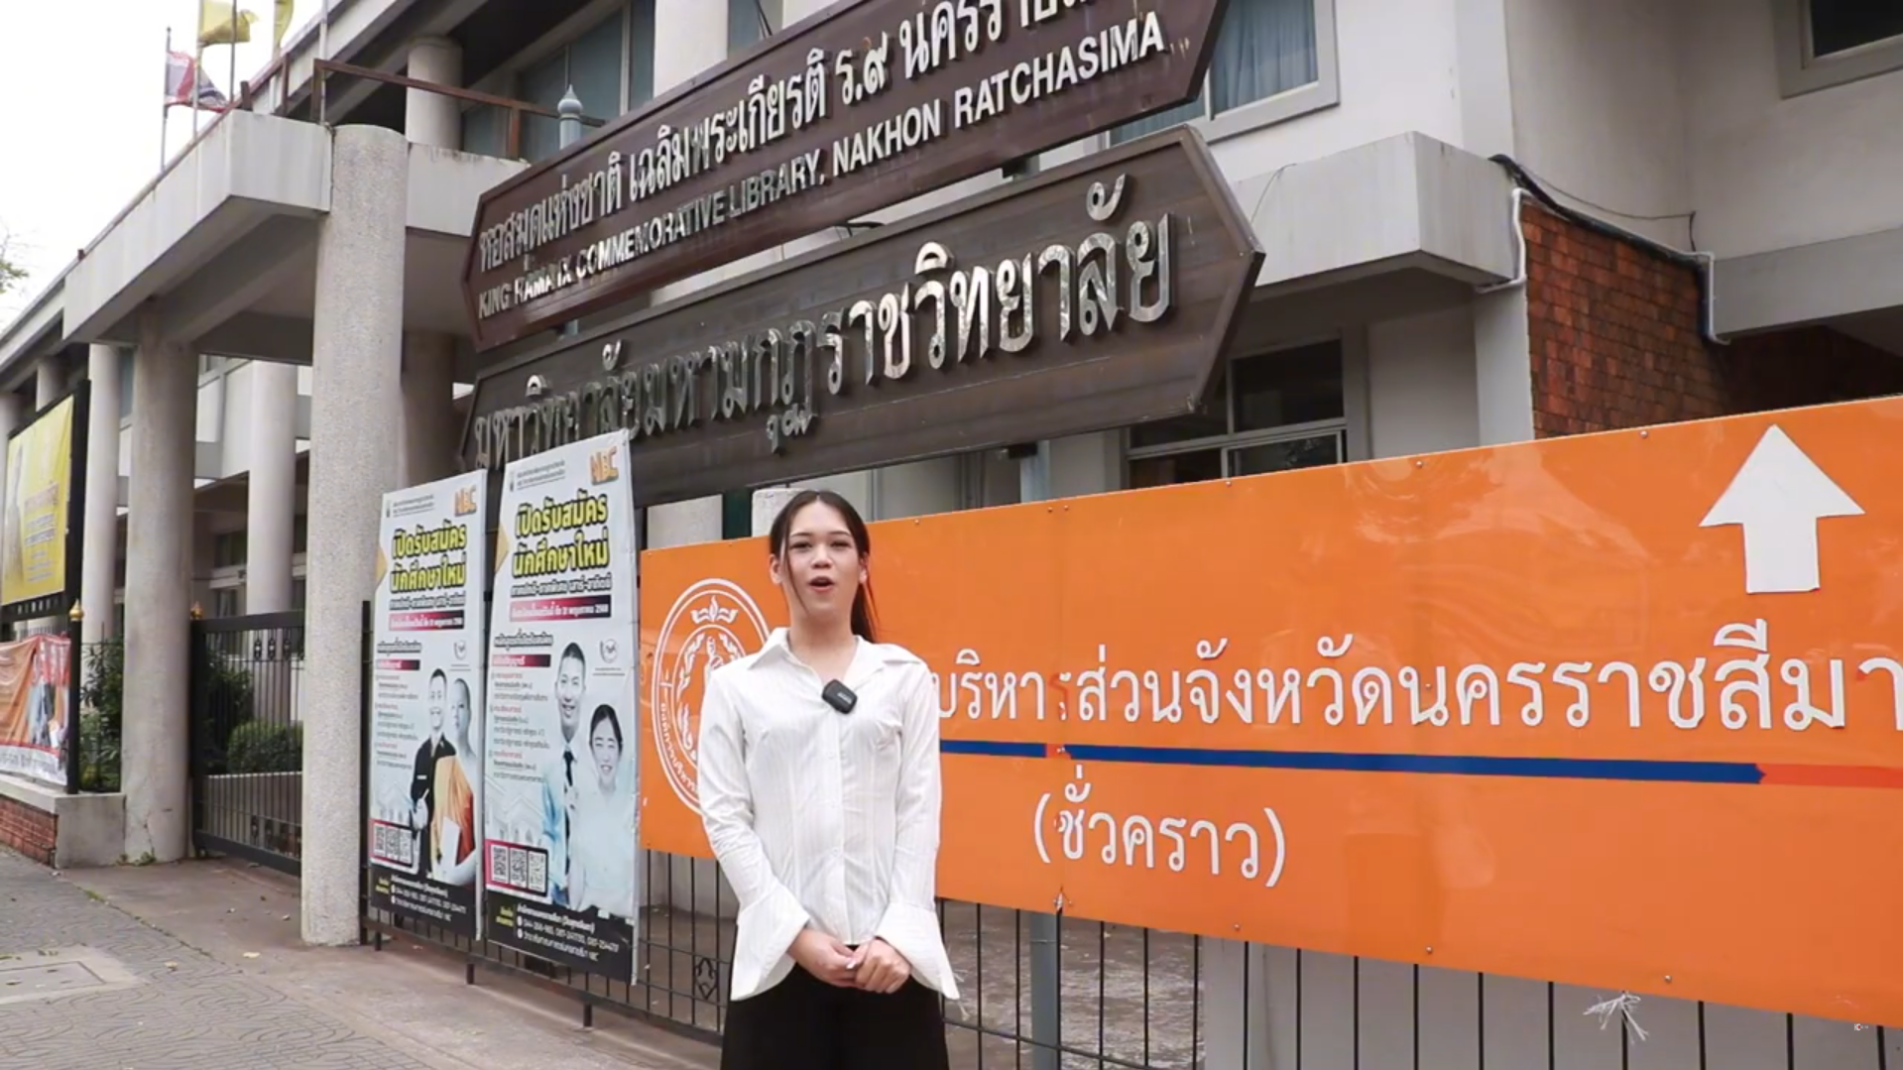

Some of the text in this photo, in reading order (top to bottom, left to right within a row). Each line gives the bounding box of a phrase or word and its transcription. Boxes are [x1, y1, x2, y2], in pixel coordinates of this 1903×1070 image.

[629, 48, 826, 201] เฉลิมพระเกียรติ
[478, 281, 512, 319] KING
[514, 262, 556, 305] RAMA
[575, 190, 726, 279] COMMEMORATIVE
[729, 148, 826, 219] LIBRARY,
[832, 99, 941, 178] NAKHON
[954, 11, 1165, 129] RATCHASIMA
[391, 518, 467, 560] เปิดรับสมัคร
[515, 488, 609, 539] เปิดรับสมัคร
[389, 551, 467, 594] นักศึกษาใหม่
[512, 526, 611, 578] นักศึกษาใหม่
[1034, 764, 1285, 888] (ชั่วคราว)
